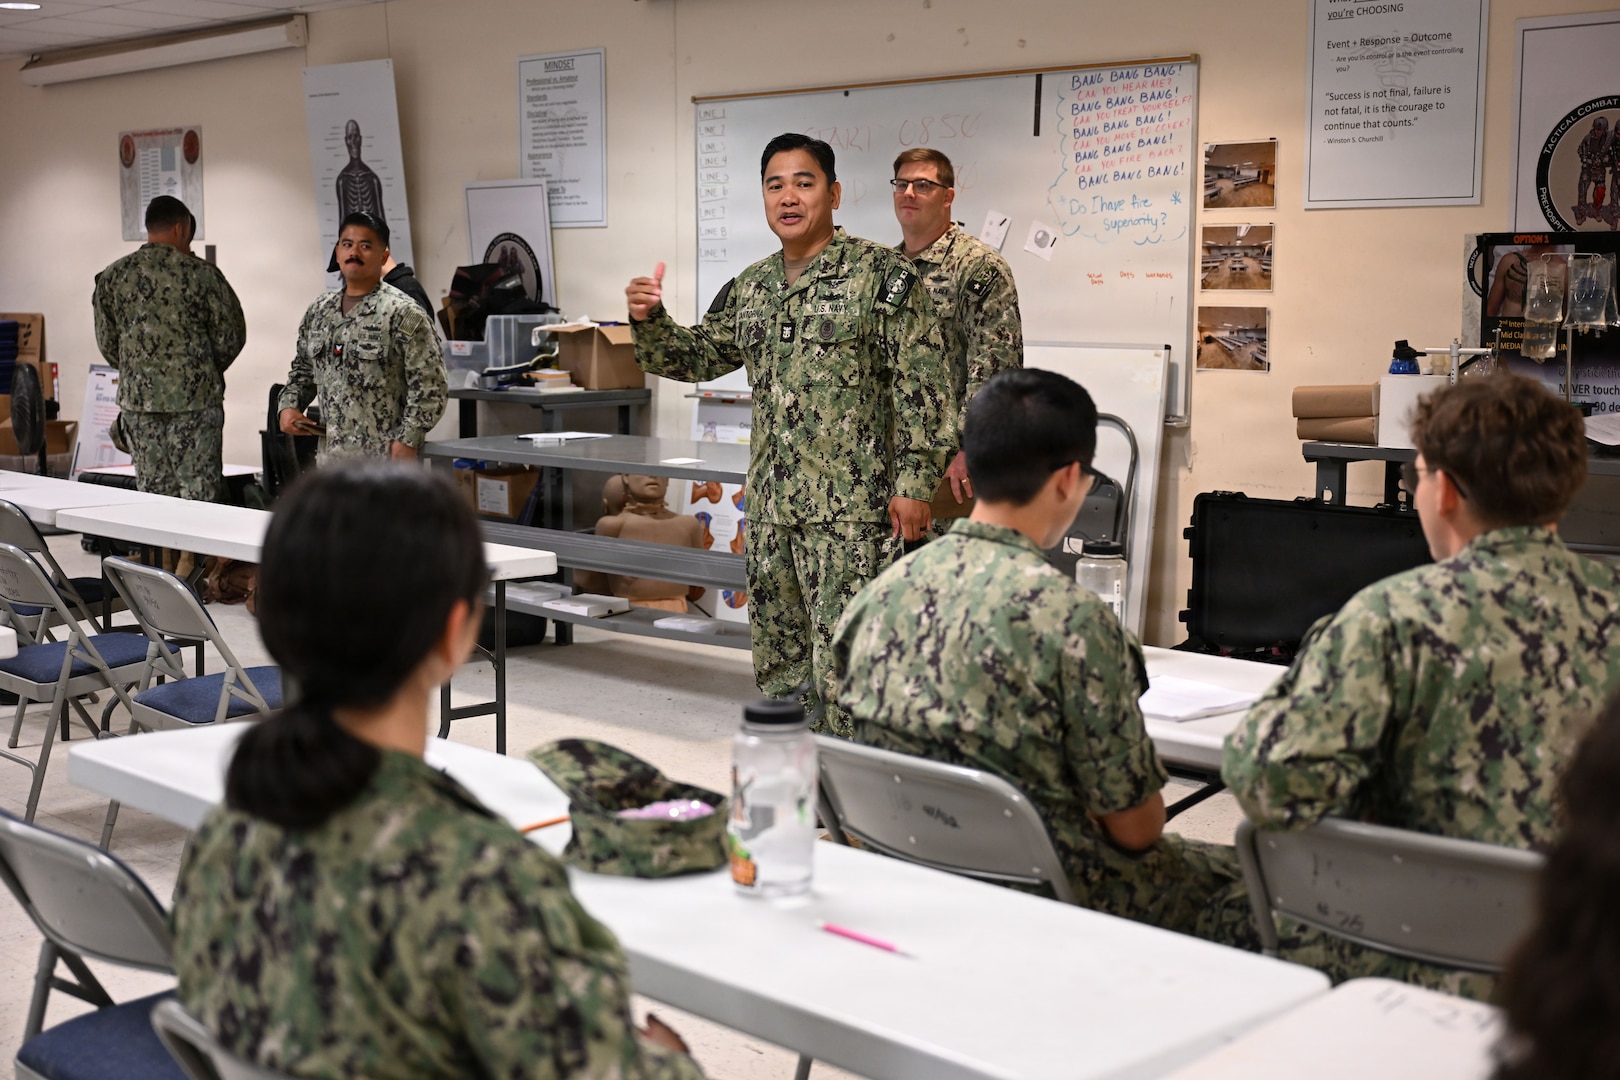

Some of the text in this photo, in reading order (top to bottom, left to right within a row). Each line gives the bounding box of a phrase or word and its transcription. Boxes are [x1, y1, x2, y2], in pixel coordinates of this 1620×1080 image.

[1328, 4, 1404, 20] you're CHOOSING
[1327, 40, 1350, 49] Event
[1360, 36, 1401, 49] Response
[1411, 32, 1452, 42] Outcome
[544, 58, 575, 71] MINDSET
[1348, 56, 1359, 64] you
[1366, 52, 1387, 60] control
[1431, 46, 1464, 56] controlling
[1070, 64, 1182, 90] BANG BANG BANG!
[1336, 65, 1350, 74] you?
[1077, 78, 1172, 101] CAN YOU HEAR ME?
[1364, 90, 1370, 99] is
[1372, 90, 1388, 98] not
[1390, 87, 1411, 98] final,
[1414, 86, 1442, 96] failure
[1444, 85, 1451, 94] is
[1071, 86, 1178, 116] BANG BANG BANG!
[1074, 94, 1192, 127] CAN YOU TREAT YOURSELF?
[1324, 102, 1445, 116] not fatal, it is the courage to
[1074, 110, 1171, 140] BANG BANG BANG!
[1324, 121, 1361, 131] continue
[1363, 120, 1380, 128] that
[1543, 98, 1619, 156] TACTICAL COMBAT
[1074, 140, 1090, 151] CAN
[1096, 136, 1110, 148] YOU
[1114, 131, 1136, 142] MOVE
[1140, 127, 1150, 136] TO
[1075, 132, 1173, 164] BANG BANG BANG!
[1074, 165, 1092, 175] CAN
[1102, 159, 1116, 170] YOU
[1119, 154, 1142, 164] FIRE
[1078, 162, 1184, 190] BANG BANG BANG!
[1069, 198, 1087, 216] Do
[1100, 196, 1126, 212] have
[1131, 194, 1152, 208] fire
[1540, 187, 1576, 232] PREHOSPIT
[1514, 234, 1550, 244] OPTION 1
[814, 304, 849, 313] U.S. NAVY
[1558, 366, 1579, 379] Oly
[1559, 384, 1590, 395] NVER
